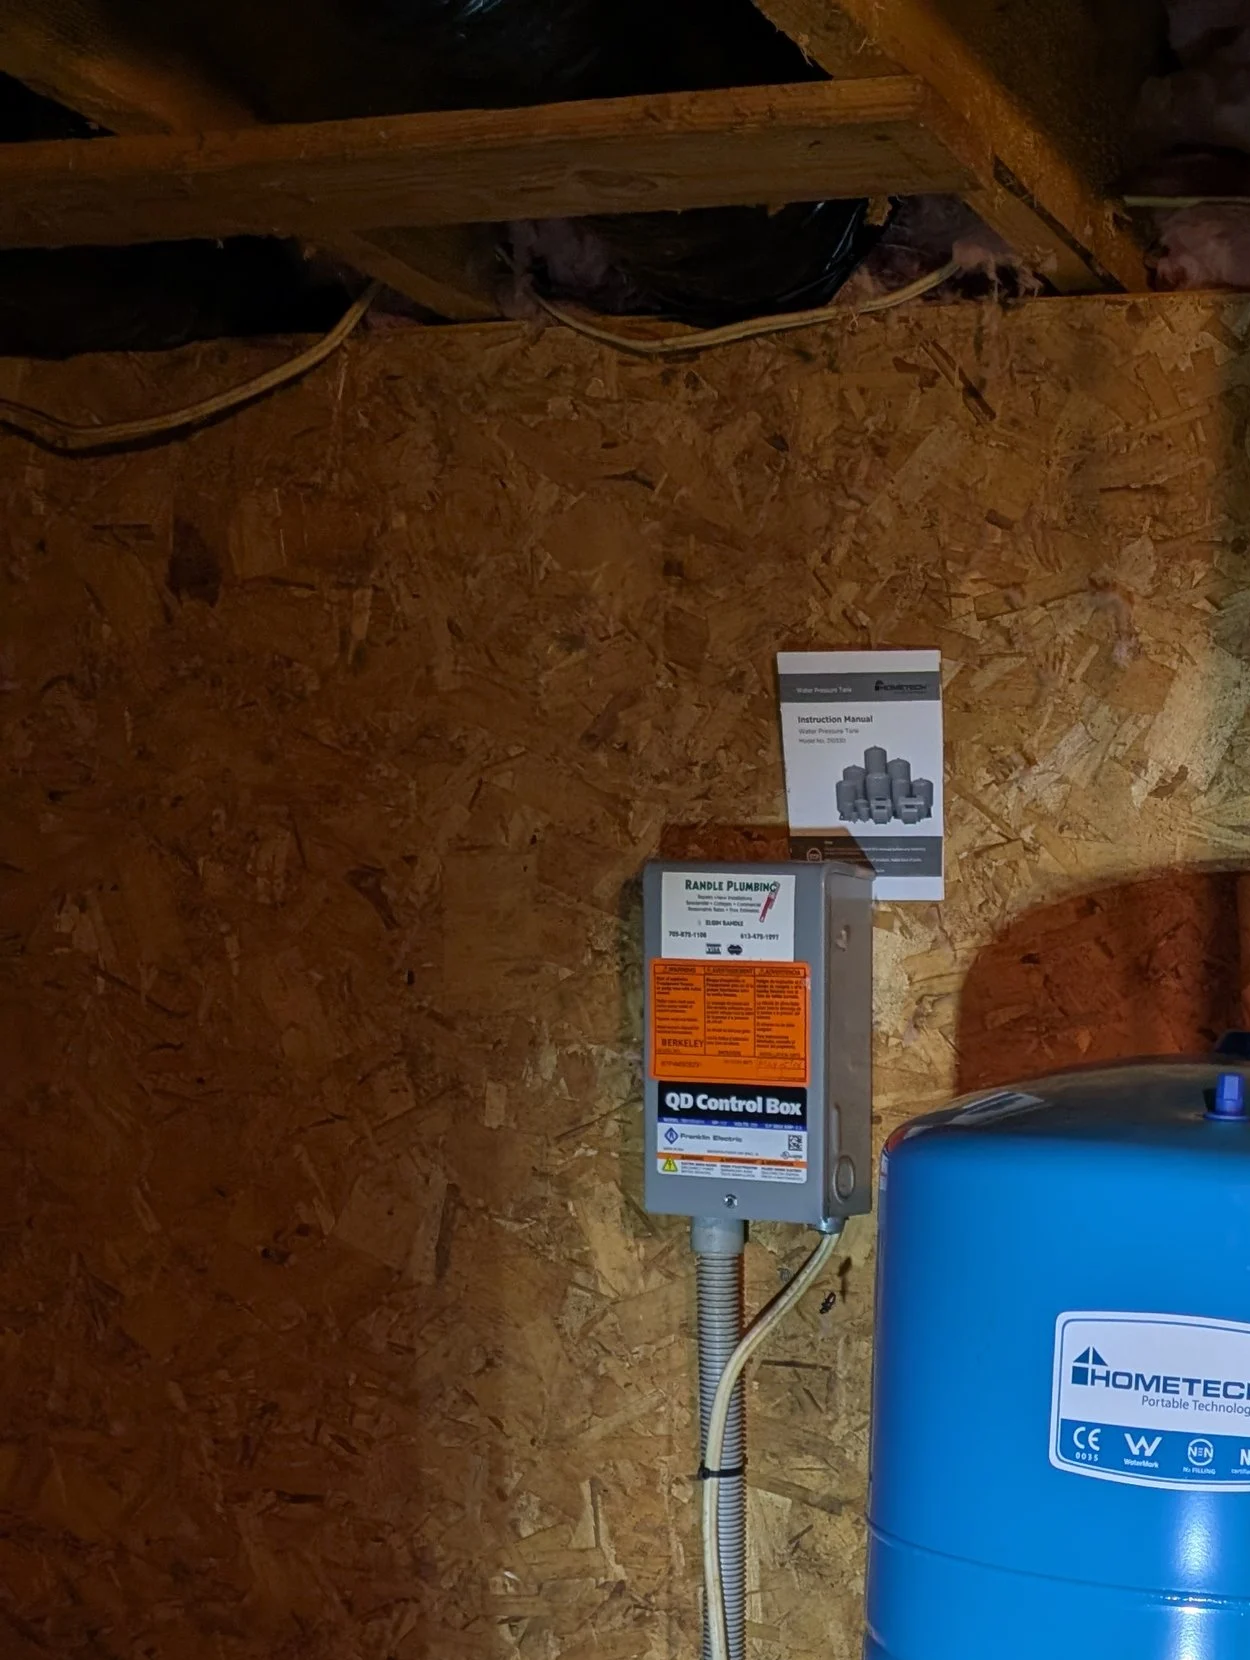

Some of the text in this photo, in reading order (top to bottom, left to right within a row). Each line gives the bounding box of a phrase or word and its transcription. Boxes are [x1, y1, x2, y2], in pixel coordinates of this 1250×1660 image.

[798, 714, 873, 724] Instruction Manual
[685, 880, 776, 892] RANDLE PLUMBING
[661, 1038, 704, 1047] BERKELEY
[665, 1092, 802, 1115] QD Control Box
[680, 1133, 743, 1143] Franklin Electric
[1142, 1395, 1190, 1411] Portable
[1075, 1452, 1099, 1462] 0035
